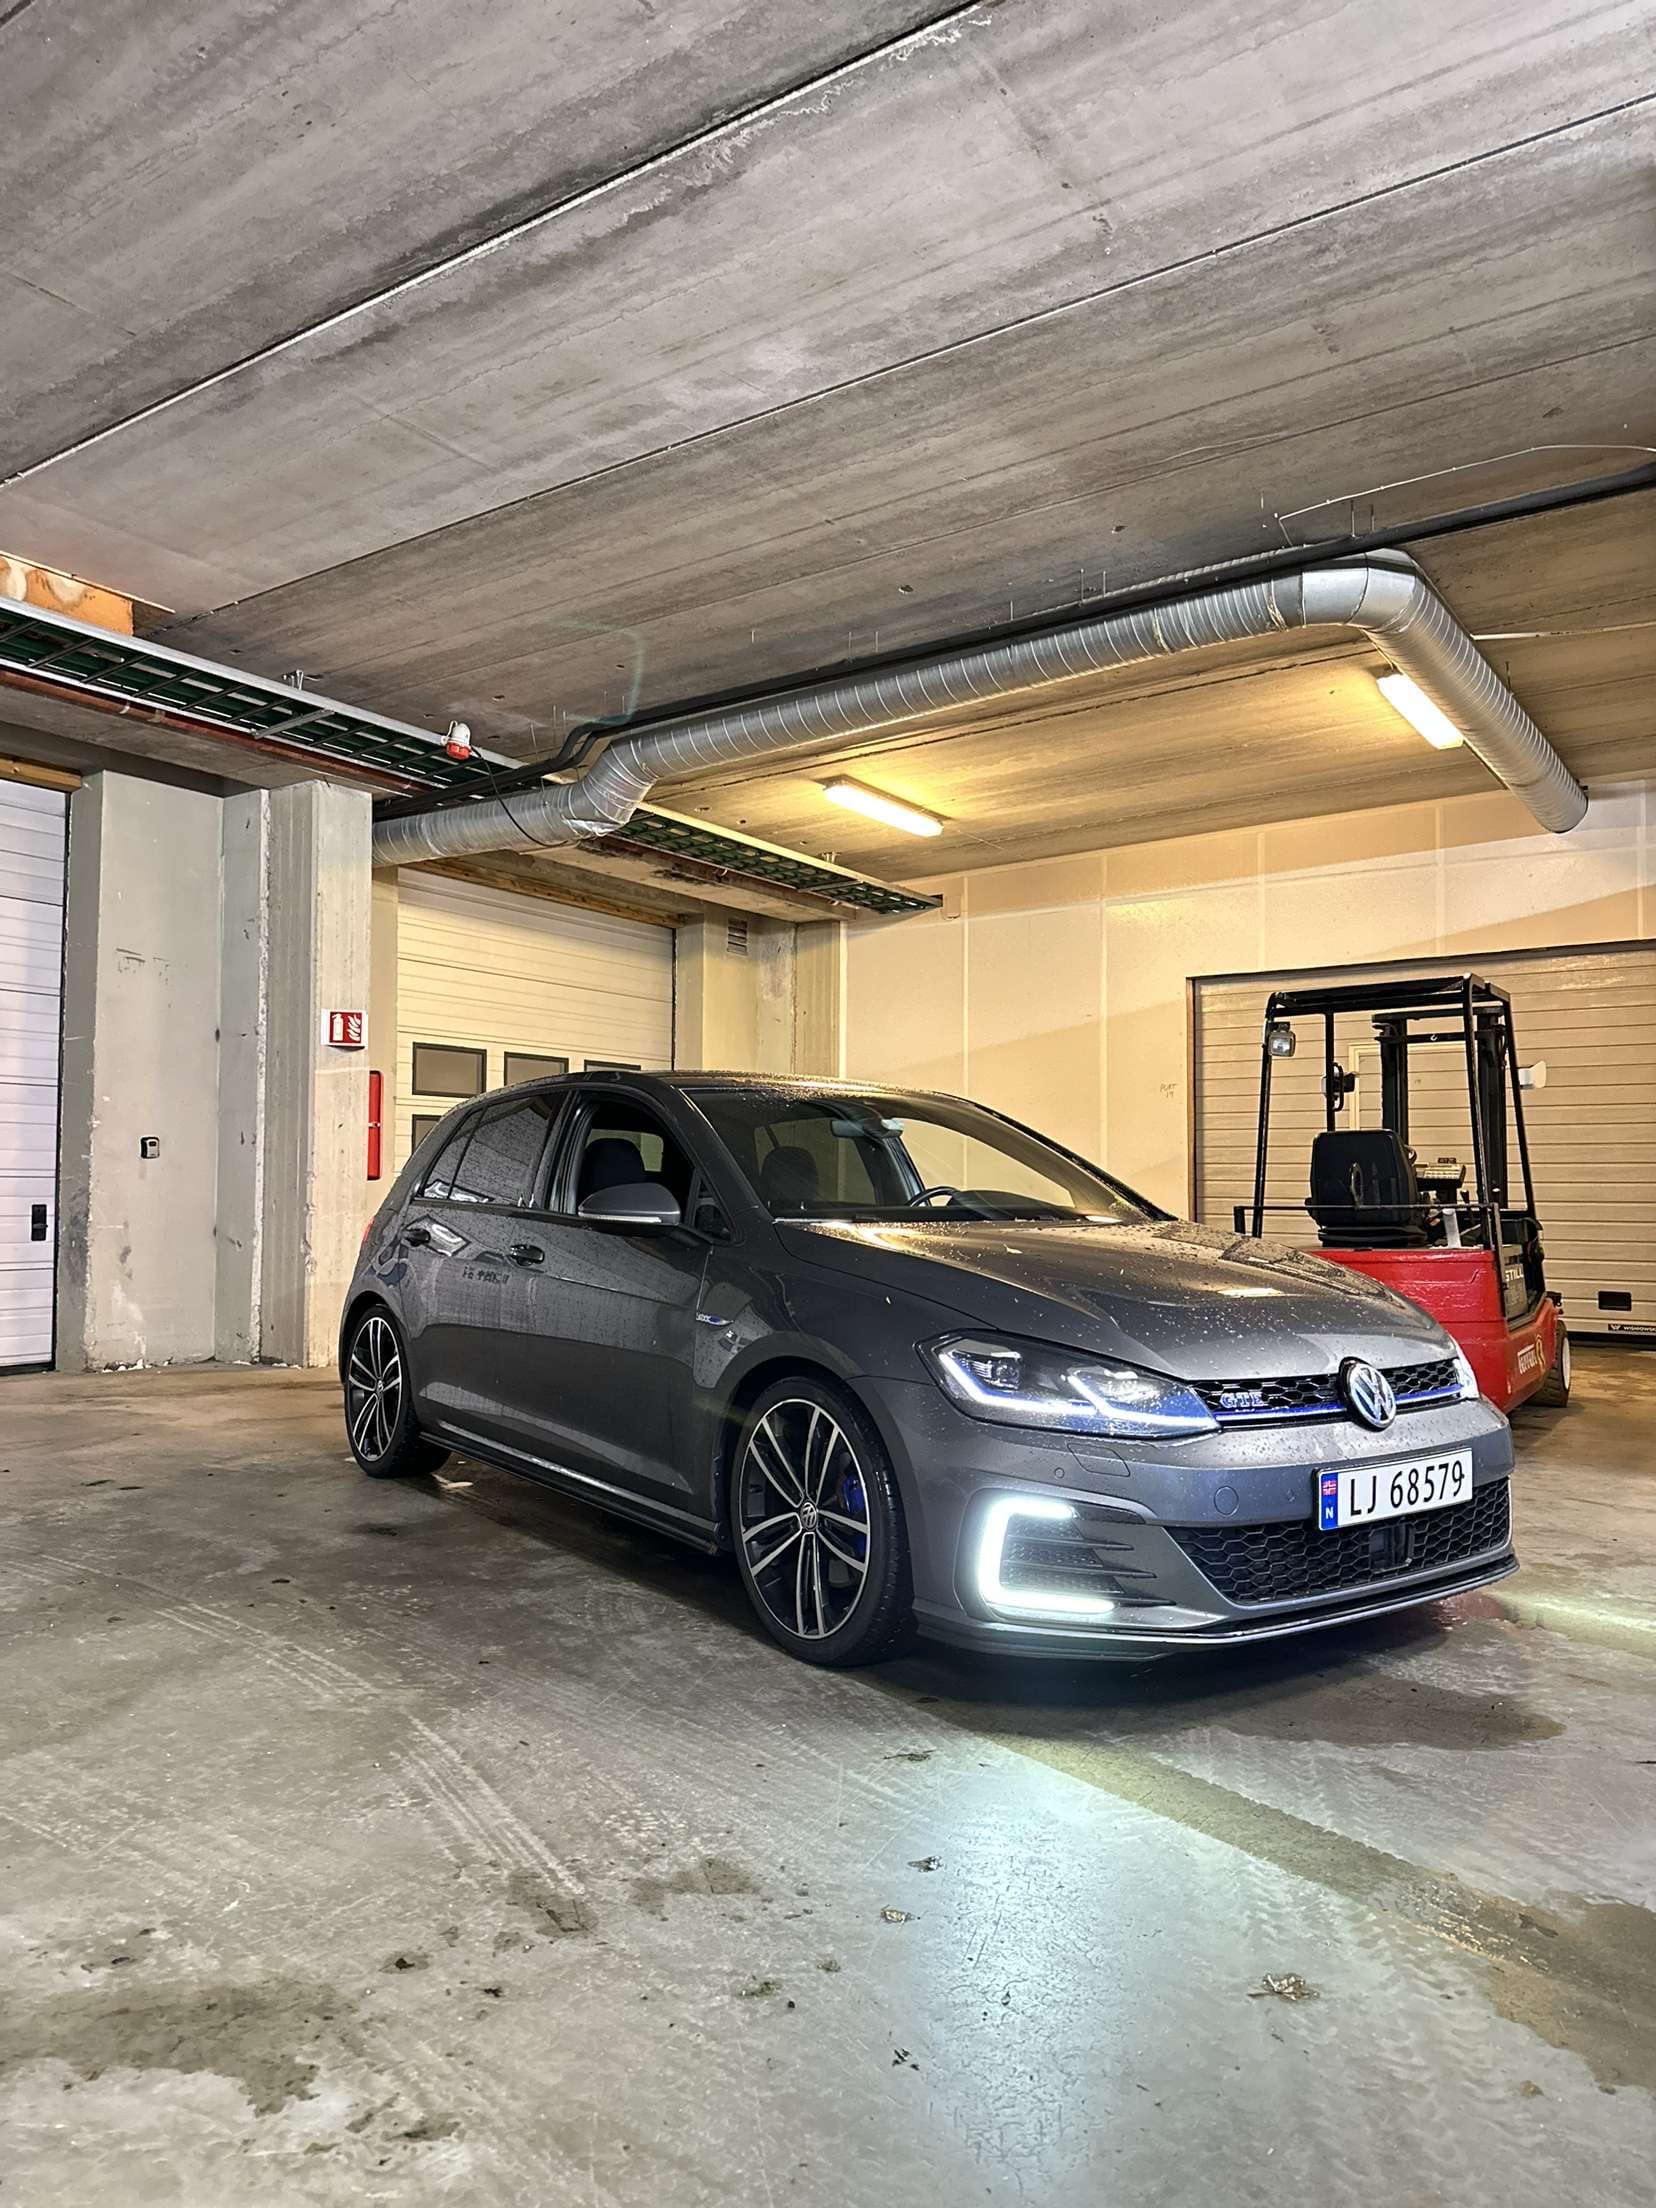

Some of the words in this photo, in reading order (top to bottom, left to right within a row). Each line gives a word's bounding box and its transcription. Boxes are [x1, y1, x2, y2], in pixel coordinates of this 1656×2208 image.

[1505, 1267, 1524, 1281] STILL
[1220, 1391, 1264, 1408] GTE
[1350, 1475, 1377, 1516] LJ
[1390, 1460, 1465, 1508] 68579
[1325, 1506, 1334, 1519] N
